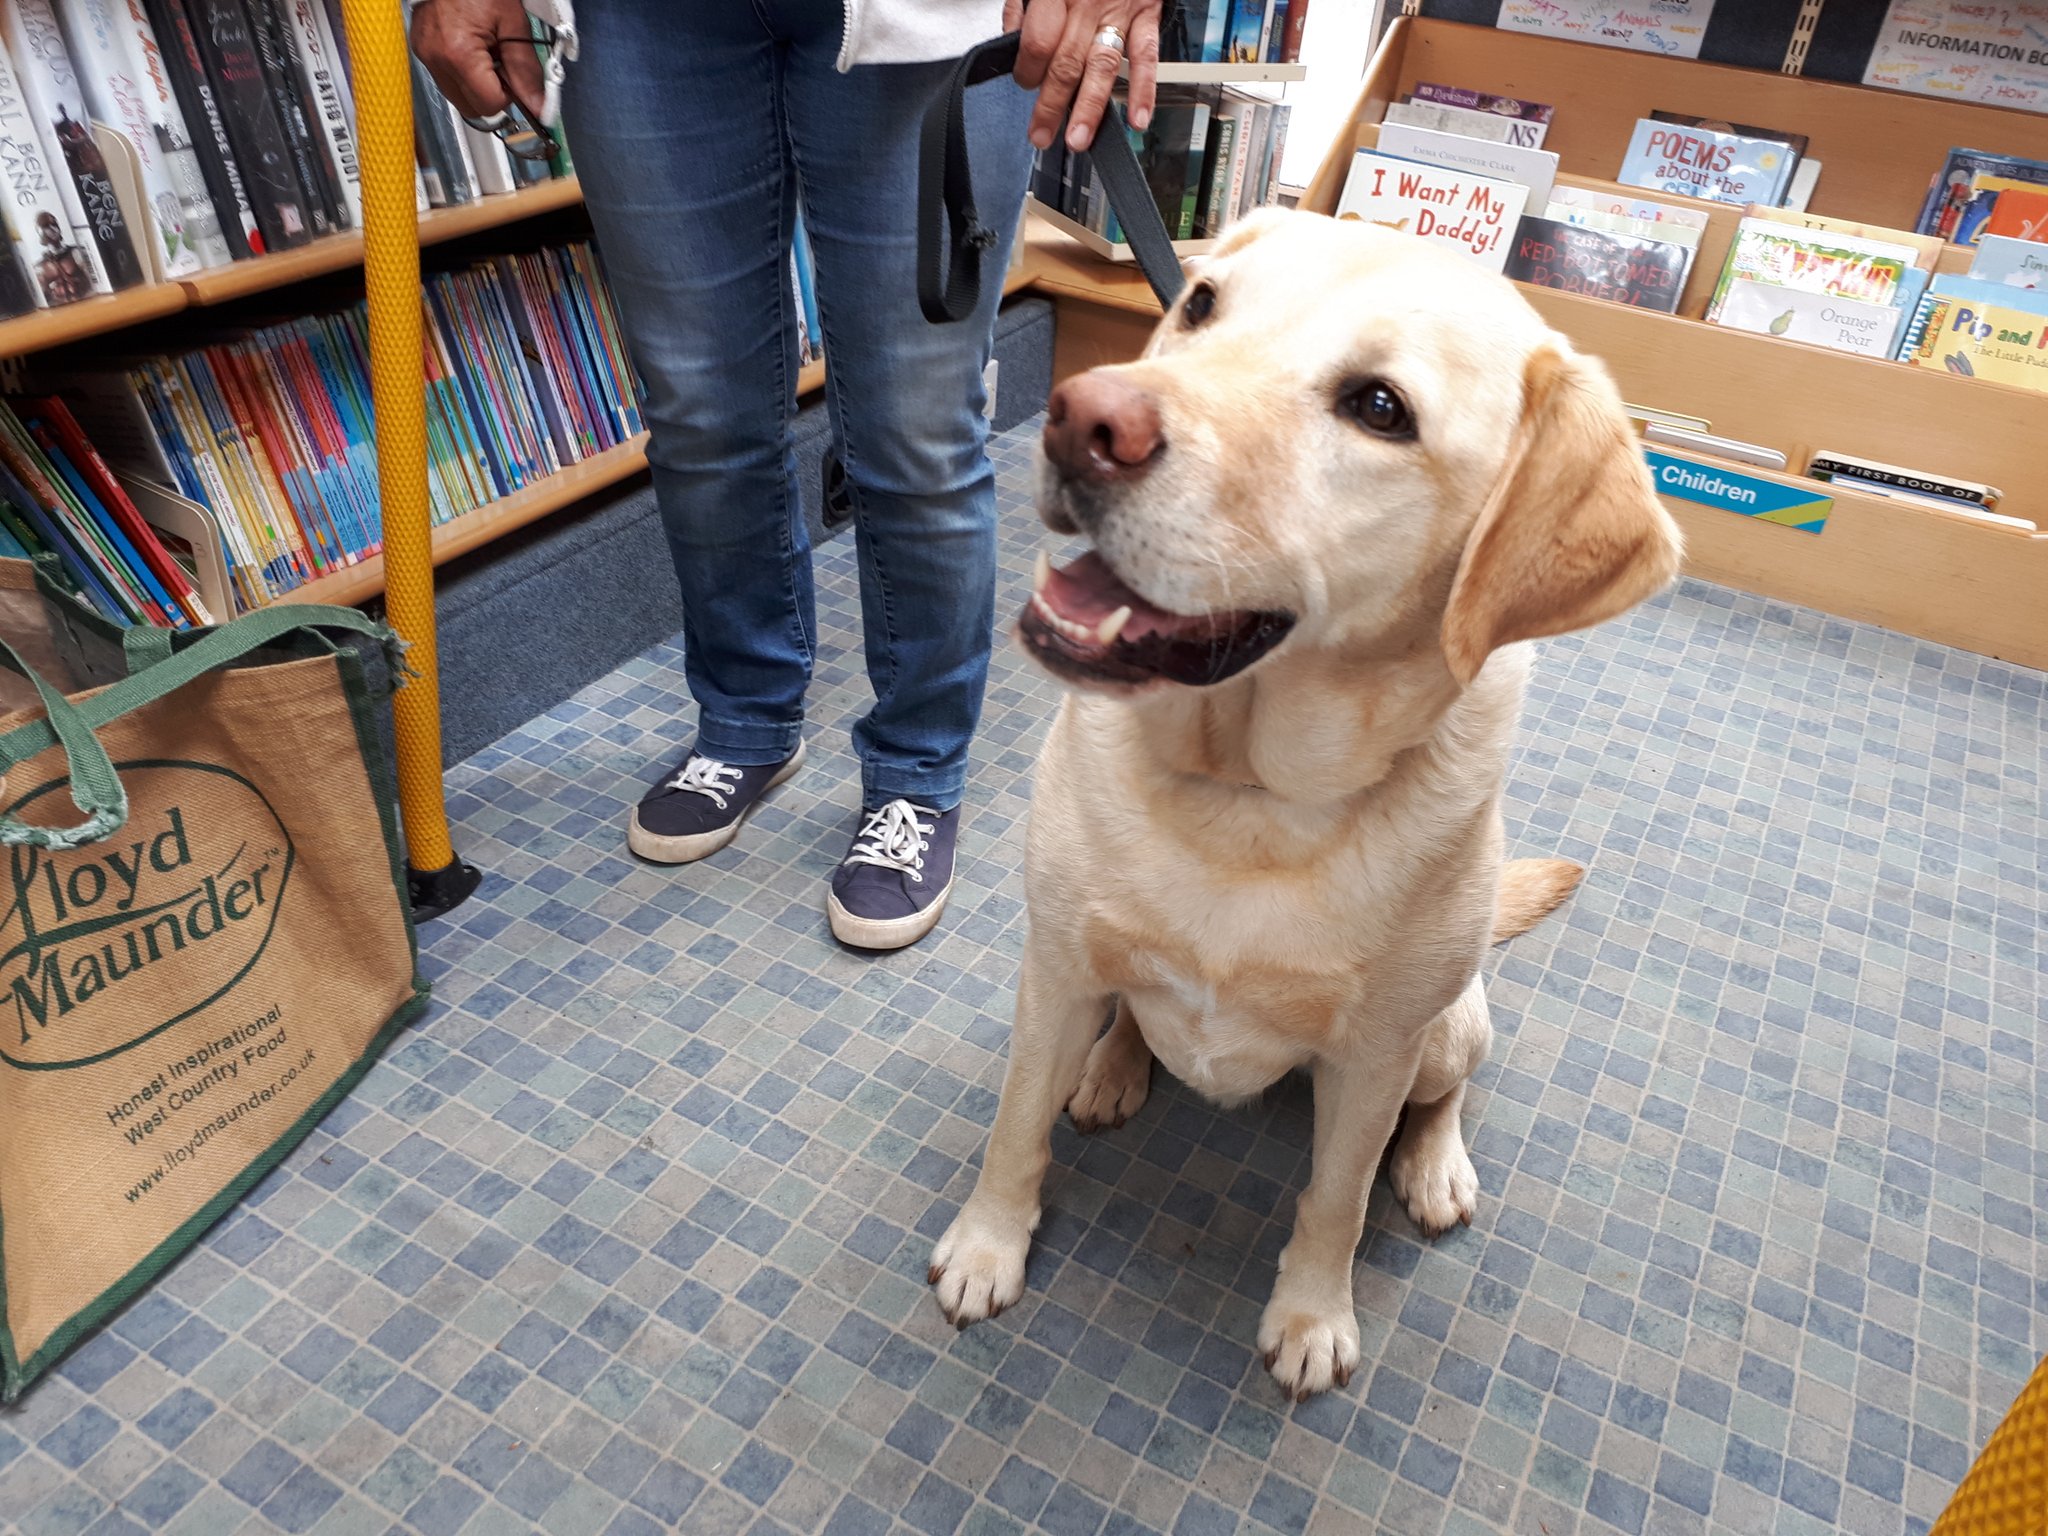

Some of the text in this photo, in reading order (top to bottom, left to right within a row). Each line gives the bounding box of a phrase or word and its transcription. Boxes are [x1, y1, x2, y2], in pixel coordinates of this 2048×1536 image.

[1512, 15, 1543, 27] PLANTS
[1612, 9, 1662, 27] ANIMALS
[137, 29, 169, 104] Maupin
[1898, 29, 2026, 62] INFORMATION
[18, 142, 50, 192] BEN
[198, 84, 250, 213] DENISE MINA
[1413, 145, 1517, 173] EMMA CHICHESTER CLARK
[1645, 130, 1736, 173] POEMS
[0, 134, 38, 208] KANE
[1655, 162, 1709, 188] about
[1715, 176, 1746, 195] the
[78, 173, 116, 242] KANE
[97, 180, 125, 227] BEN
[1371, 169, 1505, 226] I Want My
[1416, 208, 1503, 254] Daddy!
[1573, 236, 1601, 250] CASE
[1820, 308, 1878, 333] Orange
[1837, 329, 1873, 348] Pear
[1952, 308, 1993, 341] Pip
[1997, 329, 2033, 346] and
[1973, 344, 1992, 357] The
[1995, 349, 2023, 363] Little
[1662, 464, 1757, 505] Children
[1813, 460, 1977, 500] MY FIRST BOOK OF
[10, 863, 270, 1046] Maunder
[106, 1003, 283, 1127] Honest Inspirational
[124, 1027, 287, 1146] West Country Food
[124, 1048, 317, 1203] www.lloydmaunder.co.uk
